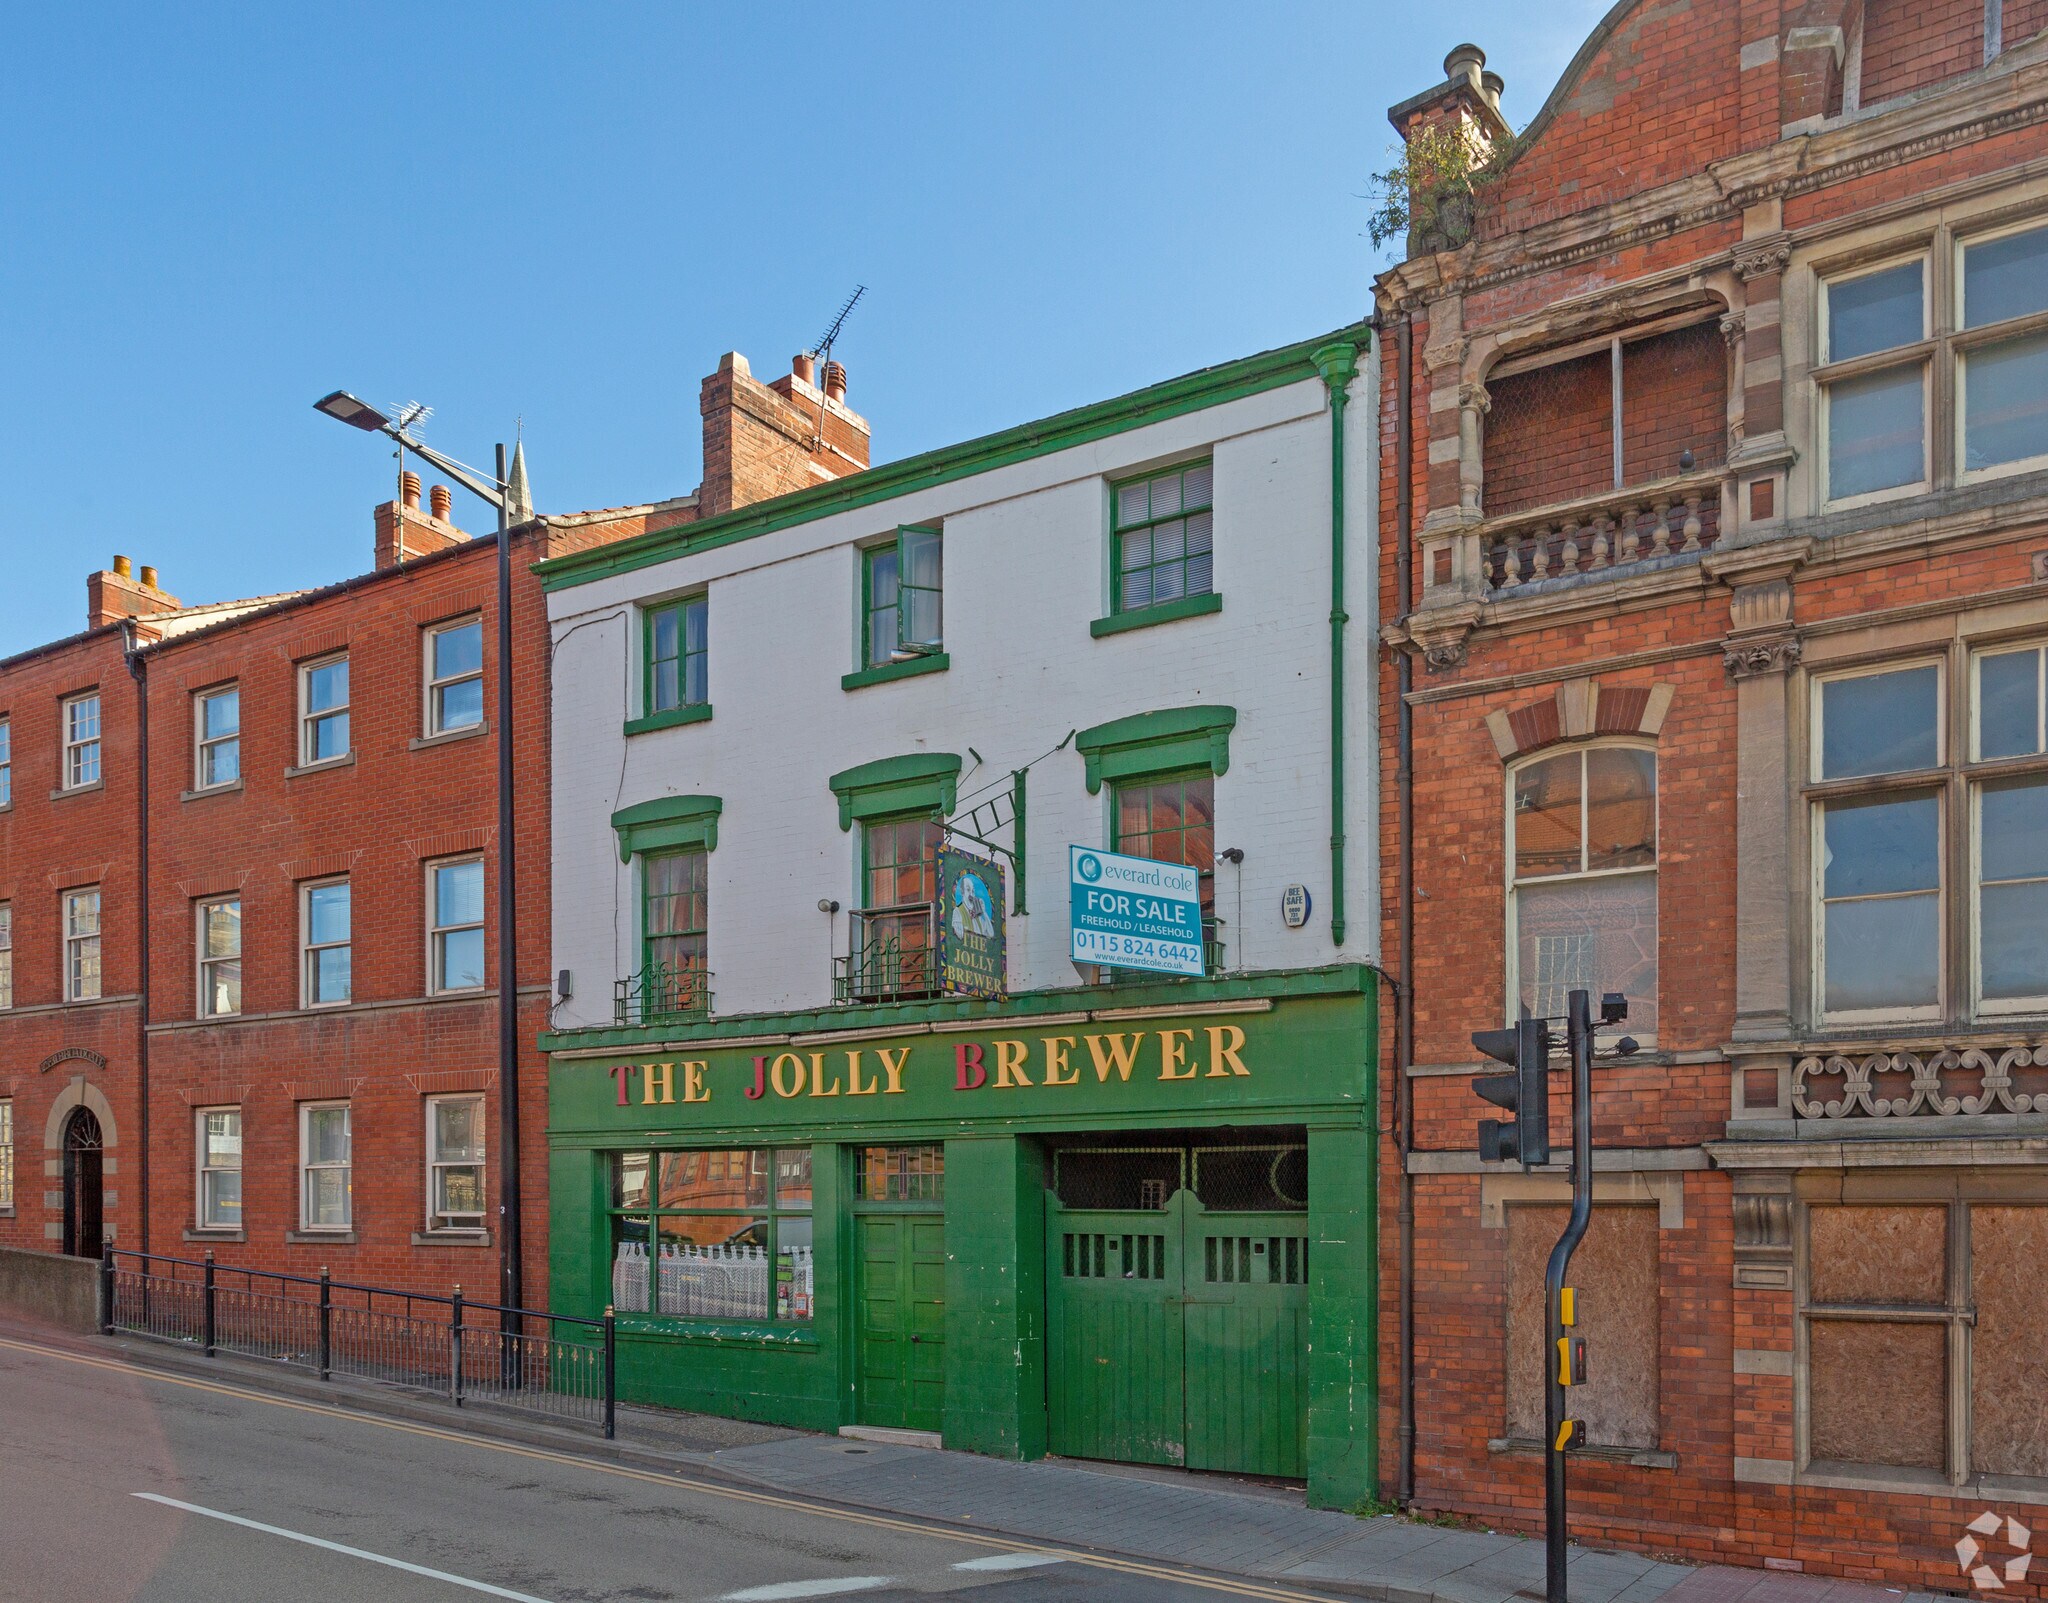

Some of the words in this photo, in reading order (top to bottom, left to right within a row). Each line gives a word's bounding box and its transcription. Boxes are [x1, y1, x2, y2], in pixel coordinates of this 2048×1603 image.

[1105, 865, 1161, 886] everard
[1164, 873, 1192, 892] cole
[1286, 896, 1303, 905] SAFE
[1288, 888, 1300, 896] BEE
[1087, 890, 1130, 916] FOR
[1135, 898, 1186, 924] SALE
[1081, 914, 1132, 931] FREEHOLD
[1139, 923, 1193, 939] LEASEHOLD
[963, 931, 987, 952] THE
[1077, 931, 1119, 952] 0115
[1123, 938, 1155, 957] 824
[1158, 943, 1198, 963] 6442
[954, 949, 994, 972] JOLLY
[1094, 952, 1184, 970] www.everardcole.co.uk
[946, 965, 1002, 993] BREWER
[608, 1060, 712, 1106] THE
[743, 1047, 912, 1100] JOLLY
[952, 1025, 1251, 1091] BREWER
